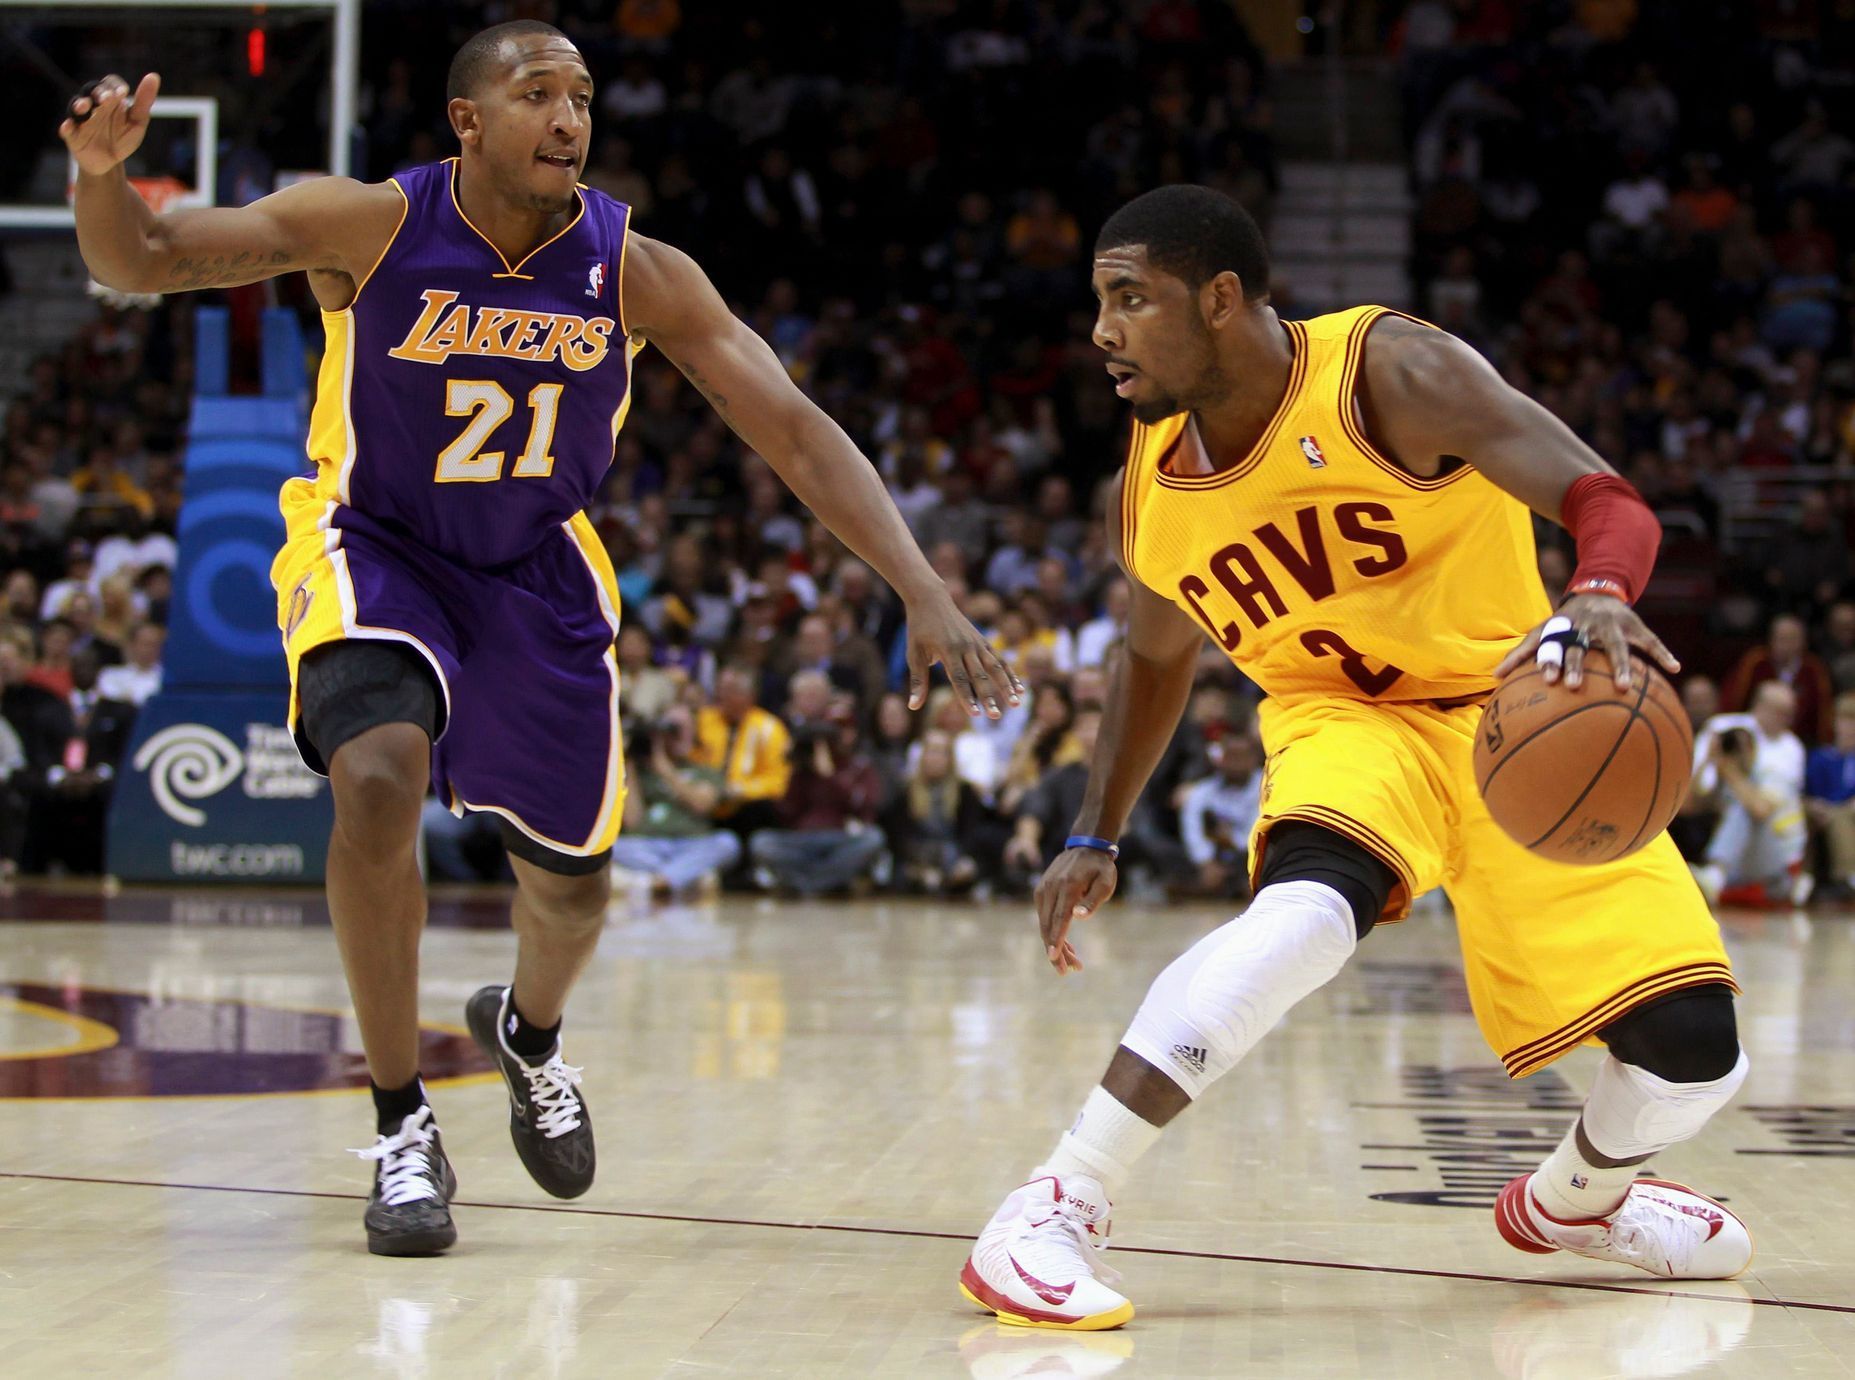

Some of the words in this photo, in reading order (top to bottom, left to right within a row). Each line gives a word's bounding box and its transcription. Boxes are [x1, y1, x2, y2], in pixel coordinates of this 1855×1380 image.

[387, 288, 616, 372] LAKERS
[433, 379, 565, 483] 21
[1178, 501, 1408, 653] CAVS
[1299, 628, 1405, 698] 2
[1058, 1190, 1097, 1215] KYRIE
